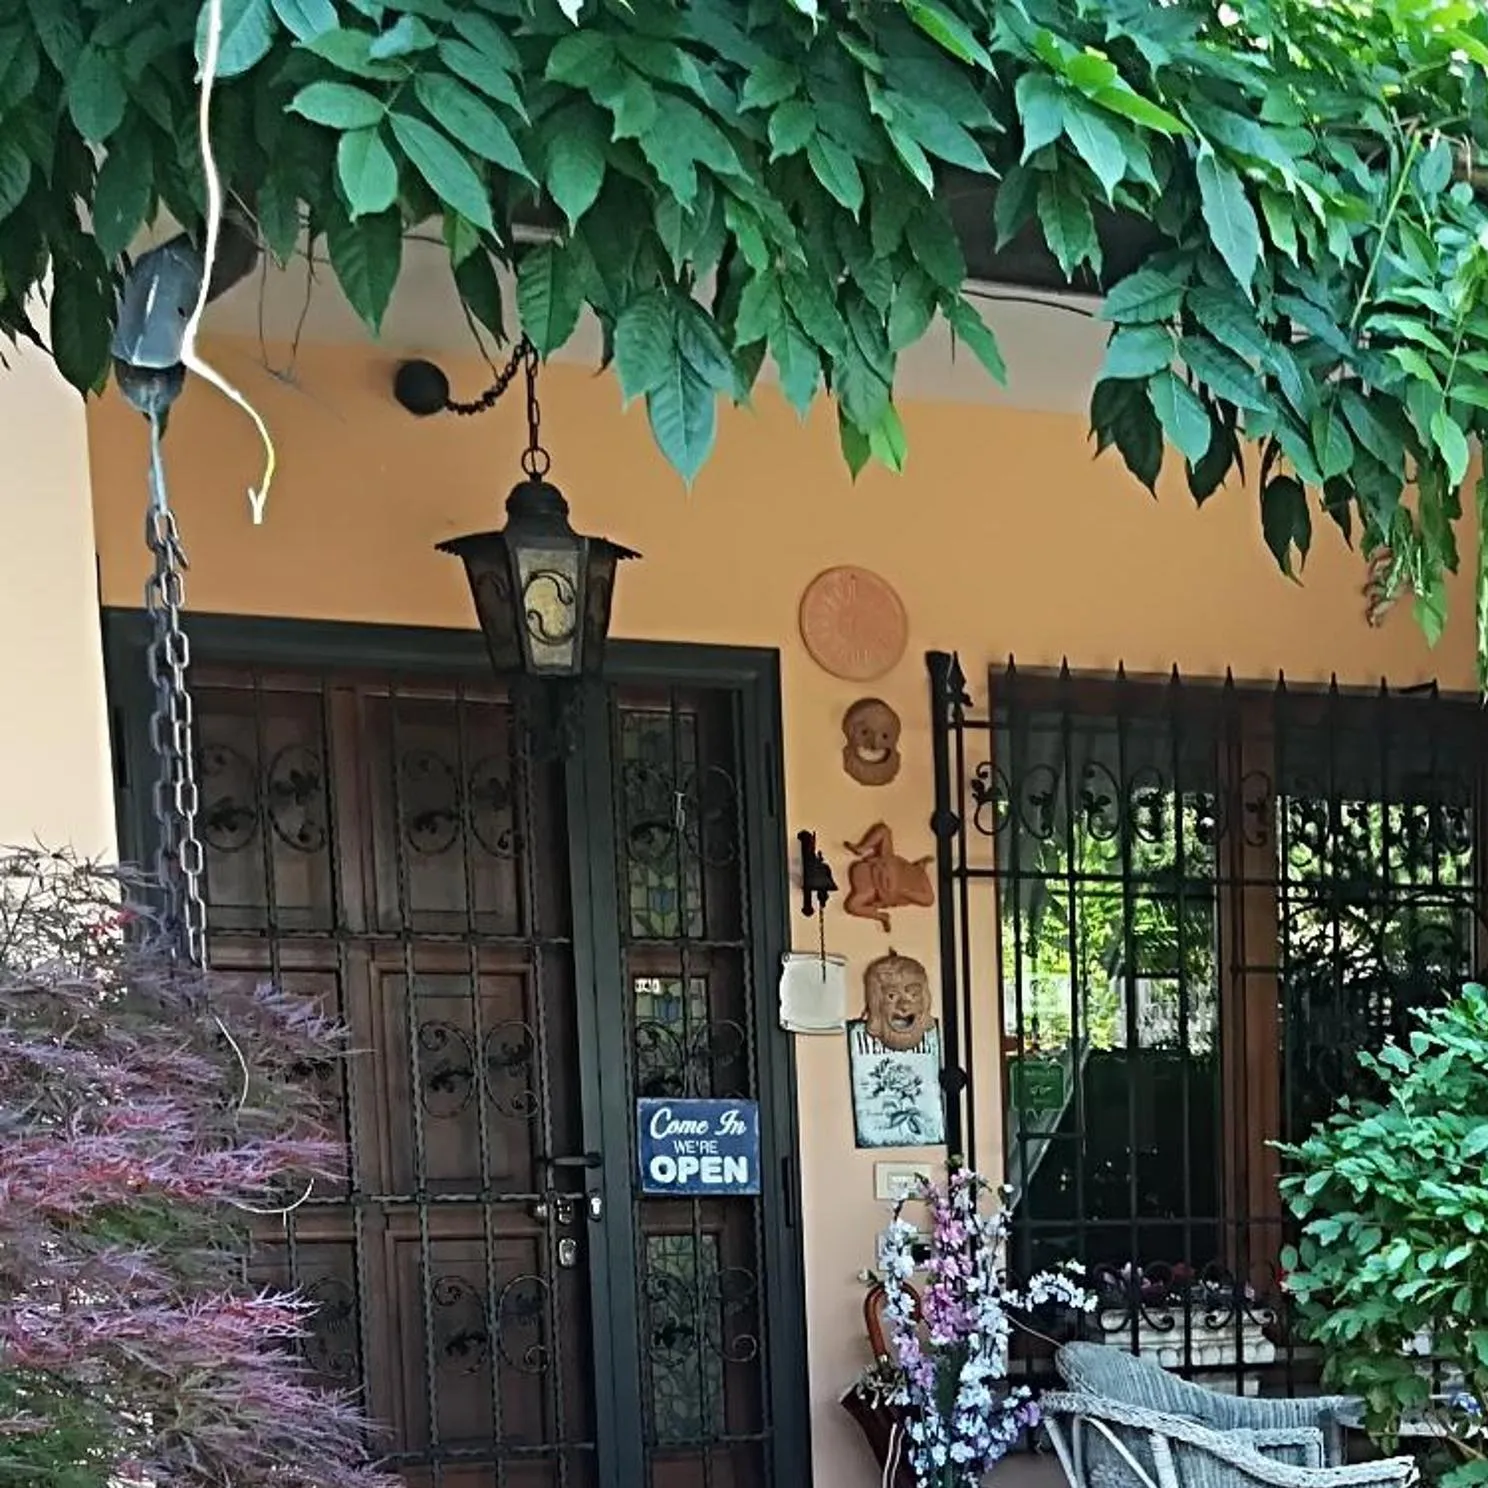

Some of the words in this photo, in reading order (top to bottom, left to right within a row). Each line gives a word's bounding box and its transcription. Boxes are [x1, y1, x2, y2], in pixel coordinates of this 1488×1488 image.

[650, 1107, 709, 1139] Come
[714, 1109, 747, 1135] In
[673, 1140, 718, 1154] WE'RE
[650, 1155, 748, 1184] OPEN
